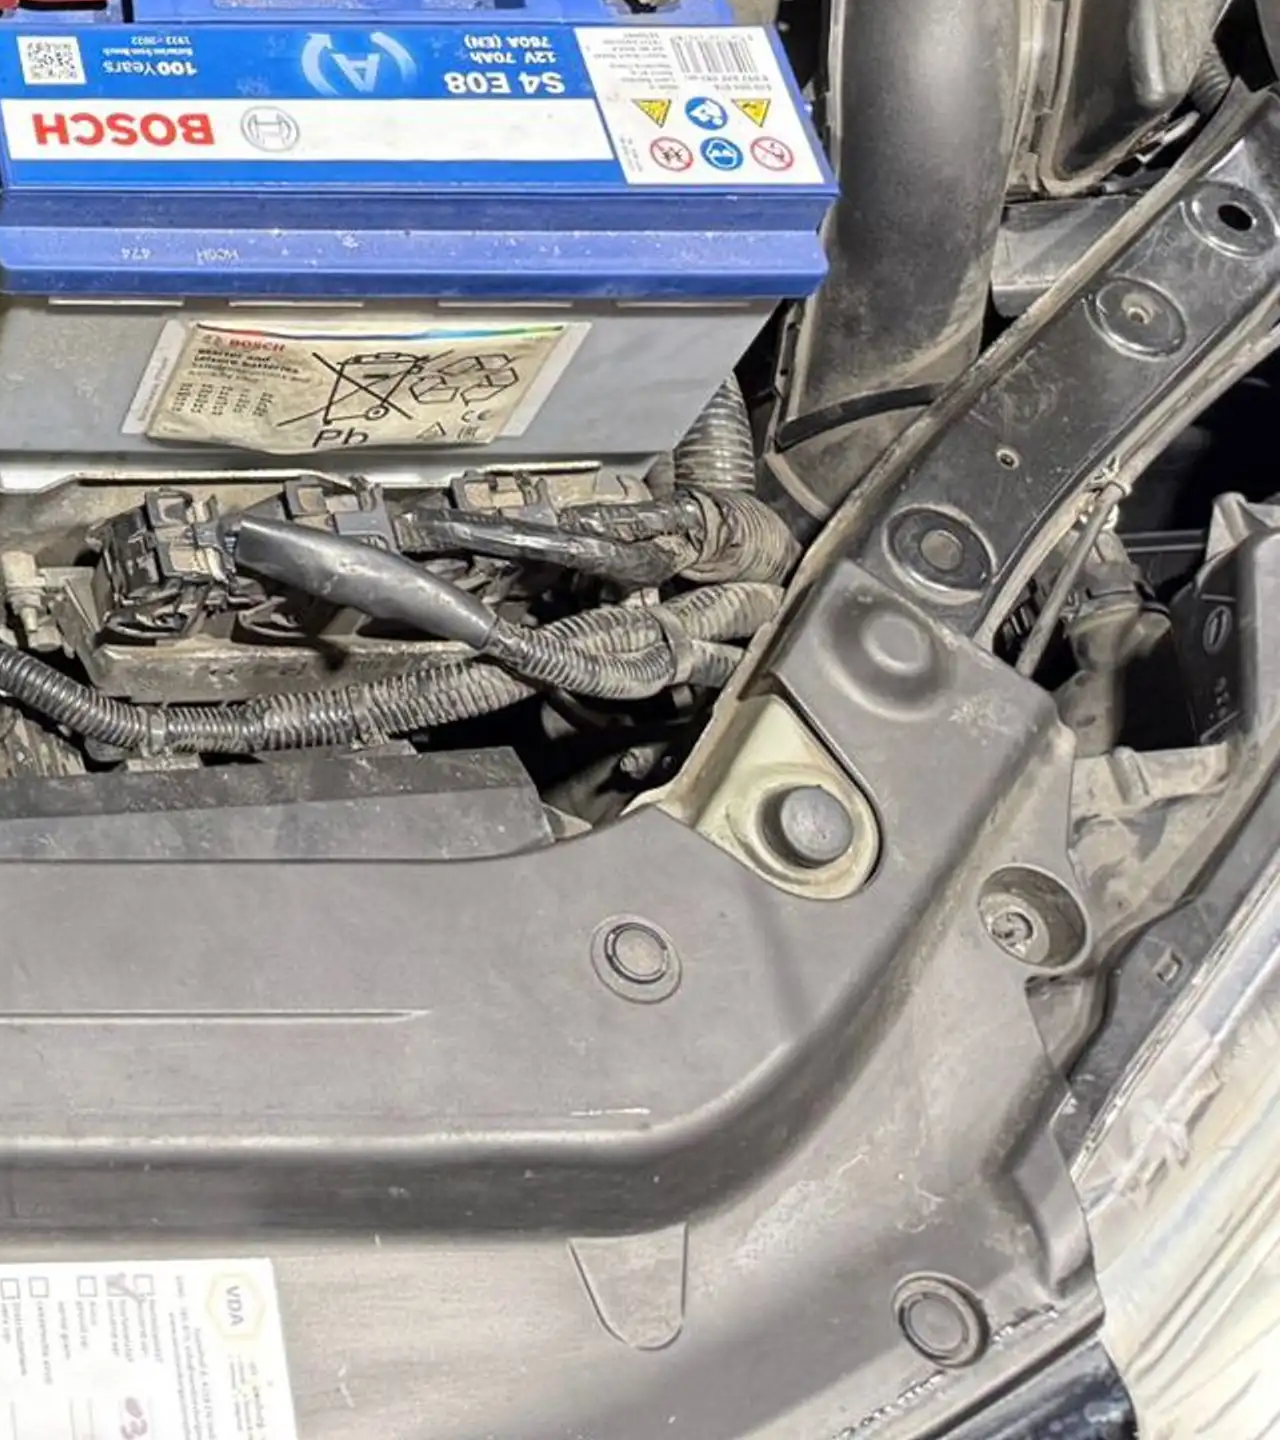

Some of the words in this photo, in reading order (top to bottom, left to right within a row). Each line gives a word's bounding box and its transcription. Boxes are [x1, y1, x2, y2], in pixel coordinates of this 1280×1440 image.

[463, 33, 502, 49] (EN)
[470, 50, 516, 64] 70Ah
[524, 50, 557, 64] 12V
[102, 60, 157, 76] Years
[157, 61, 198, 76] 100
[443, 71, 512, 93] E08
[517, 72, 566, 94] S4
[31, 112, 215, 146] BOSCH
[228, 338, 286, 352] BOSCH
[226, 1286, 244, 1325] VDA
